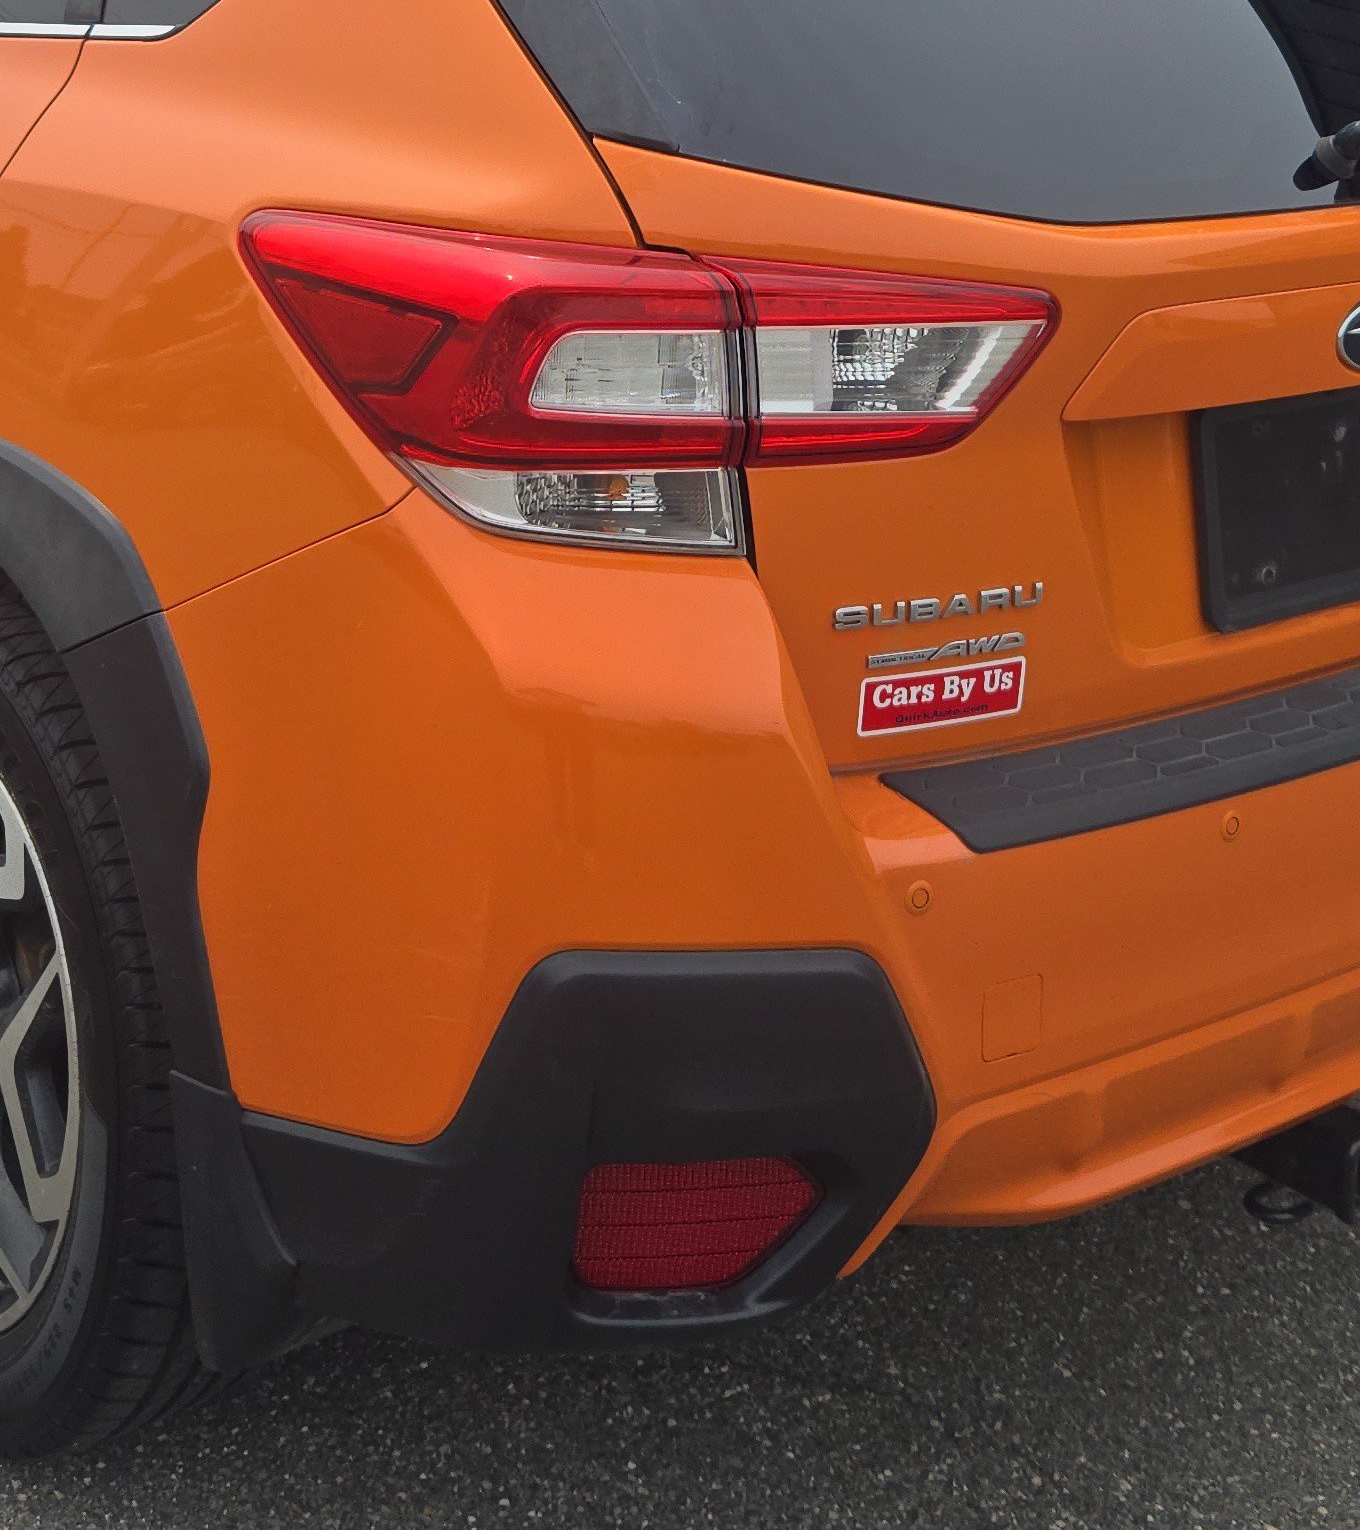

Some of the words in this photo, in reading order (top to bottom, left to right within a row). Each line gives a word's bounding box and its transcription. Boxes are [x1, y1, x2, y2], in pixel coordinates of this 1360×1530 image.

[834, 582, 1043, 630] SUBARU
[929, 631, 1026, 660] AWD
[872, 683, 935, 708] Cars
[941, 675, 977, 702] By
[983, 669, 1014, 694] Us
